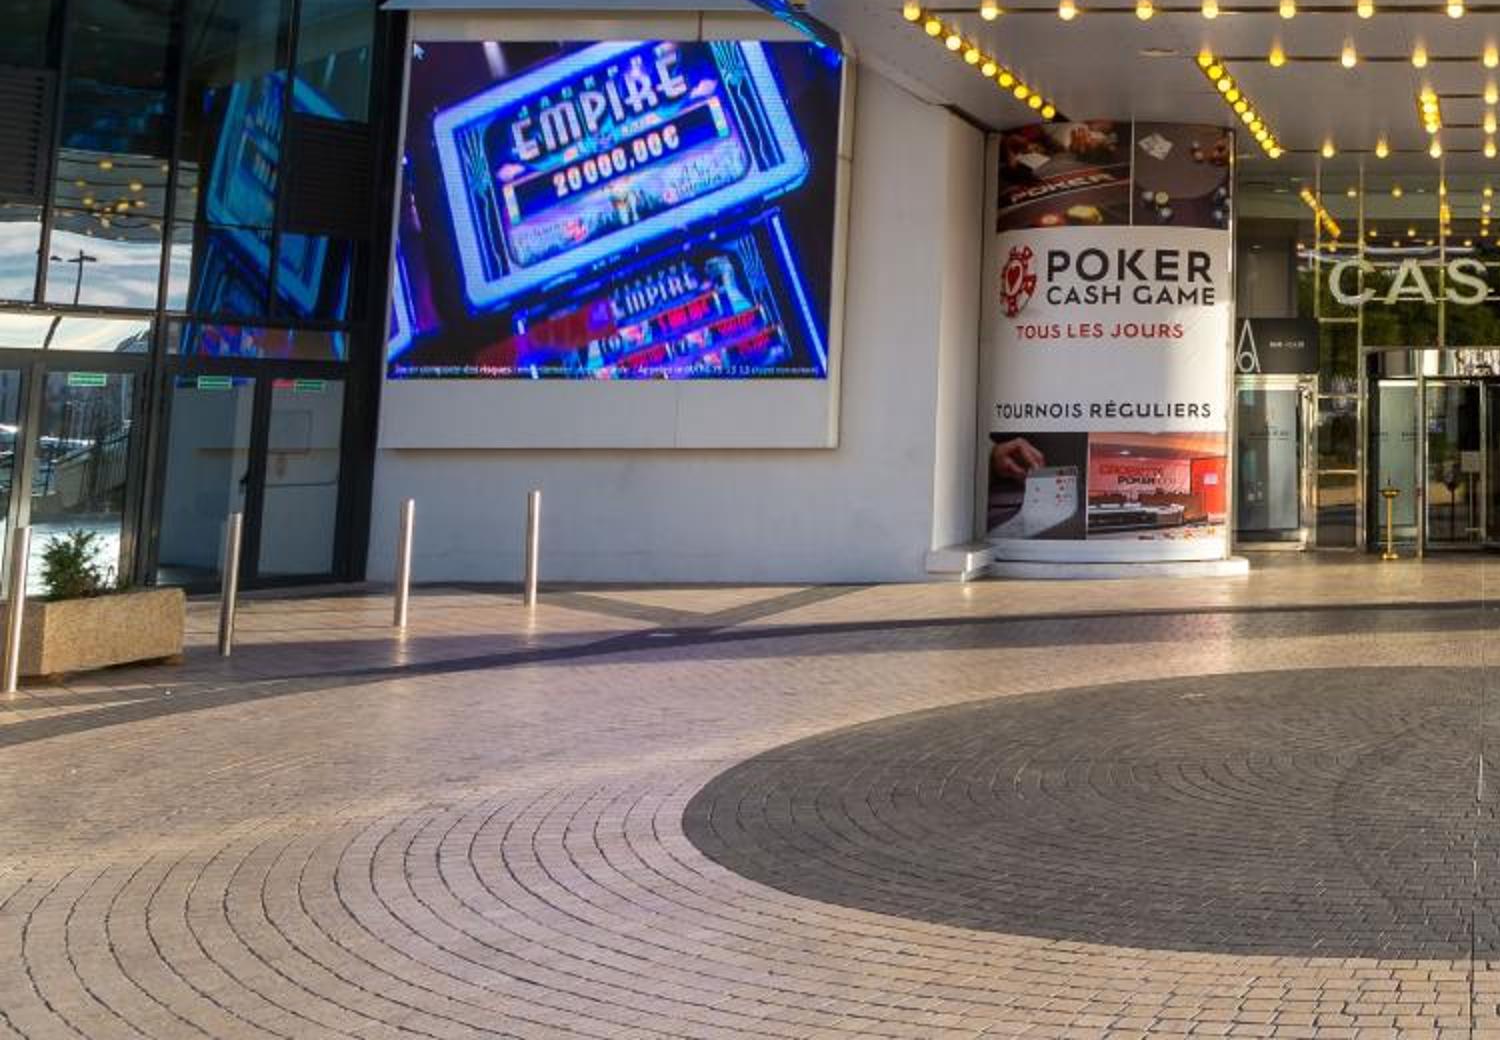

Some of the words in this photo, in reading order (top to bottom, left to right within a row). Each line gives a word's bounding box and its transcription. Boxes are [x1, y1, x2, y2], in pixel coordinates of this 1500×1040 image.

[511, 54, 688, 161] EMPIRE
[1047, 248, 1213, 283] POKER
[1047, 286, 1121, 305] CASH
[1132, 286, 1216, 306] GAME
[1016, 324, 1061, 339] TOUS
[1067, 323, 1104, 338] LES
[1110, 323, 1184, 339] JOURS
[996, 403, 1083, 419] TOURNOIS
[1089, 399, 1212, 419] RÉGULIERS
